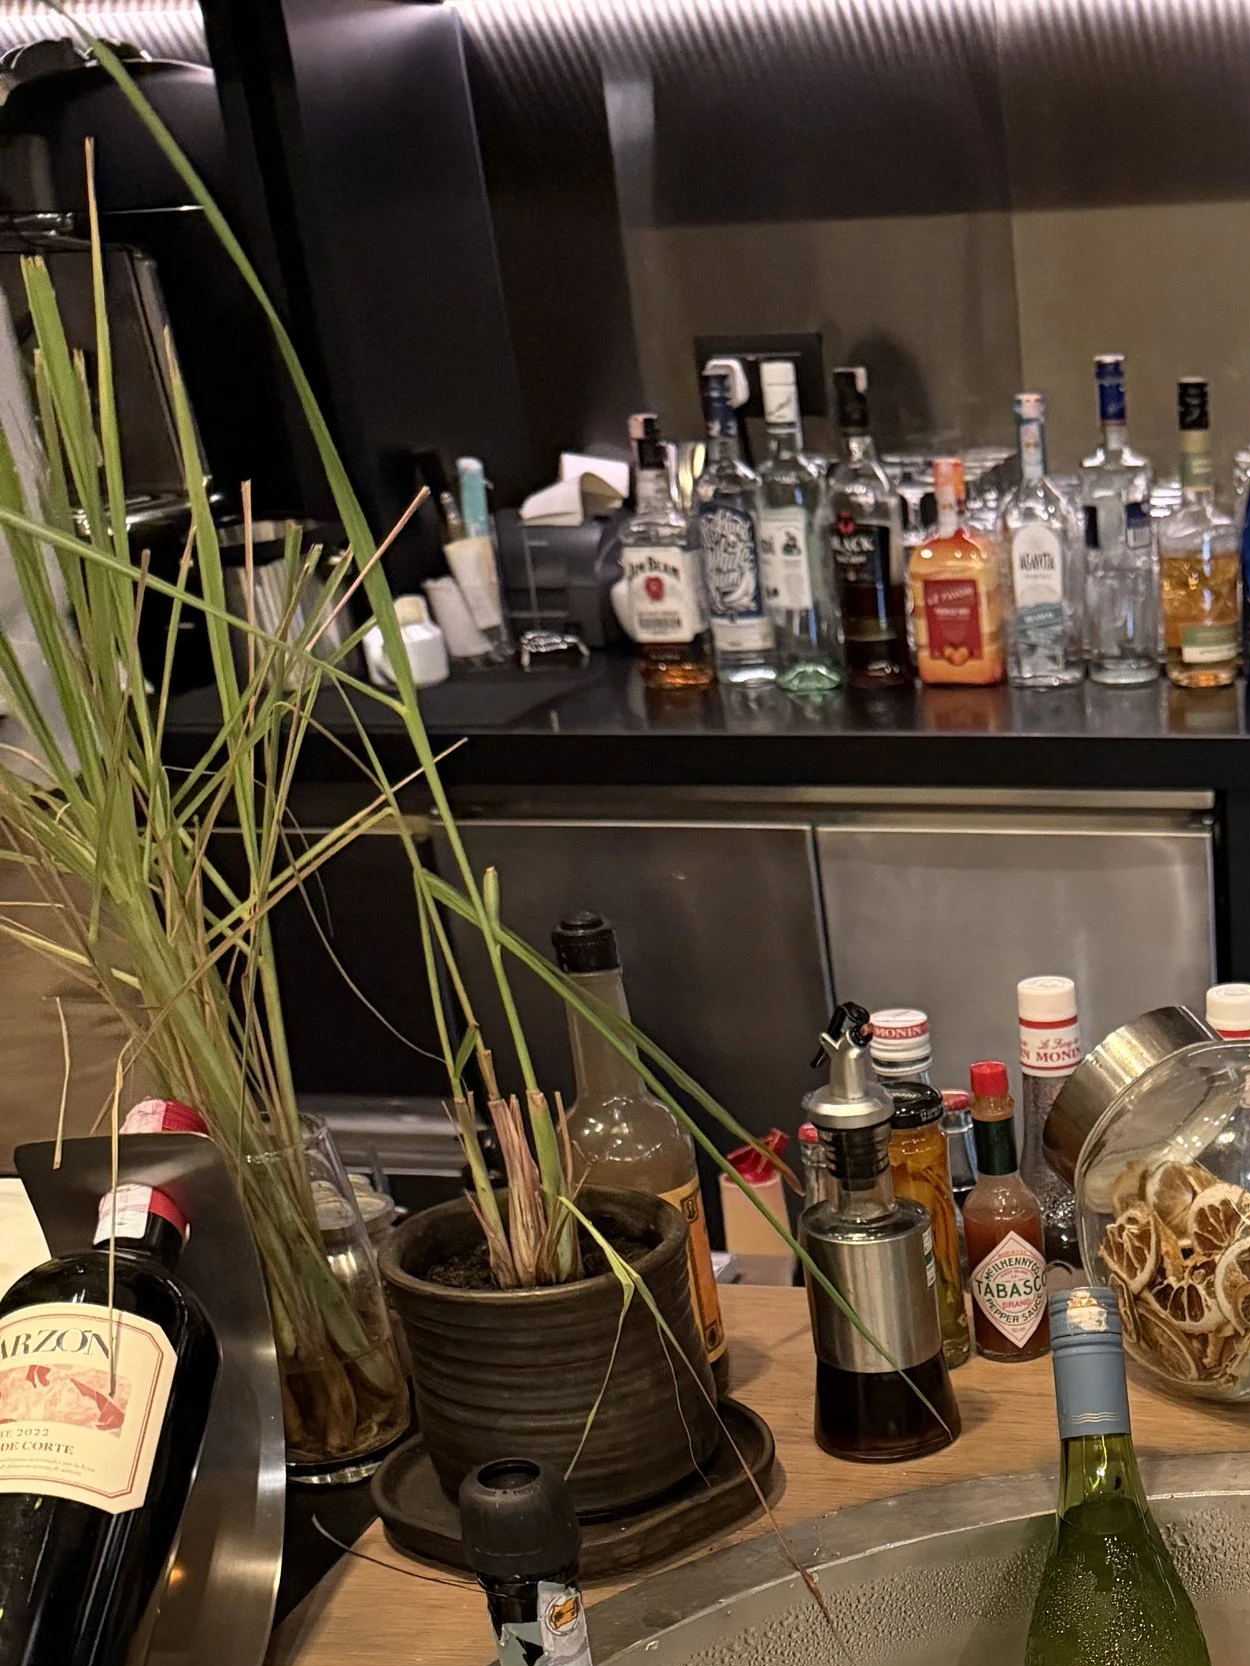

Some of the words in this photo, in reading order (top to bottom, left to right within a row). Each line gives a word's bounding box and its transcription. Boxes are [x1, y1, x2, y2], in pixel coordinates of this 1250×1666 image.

[876, 1026, 921, 1039] MONIN
[974, 1270, 1047, 1299] TABASCO
[986, 1298, 1020, 1324] PEPPER
[1021, 1294, 1043, 1322] SAUCE
[16, 1428, 50, 1438] 2022
[22, 1441, 75, 1456] CORTE
